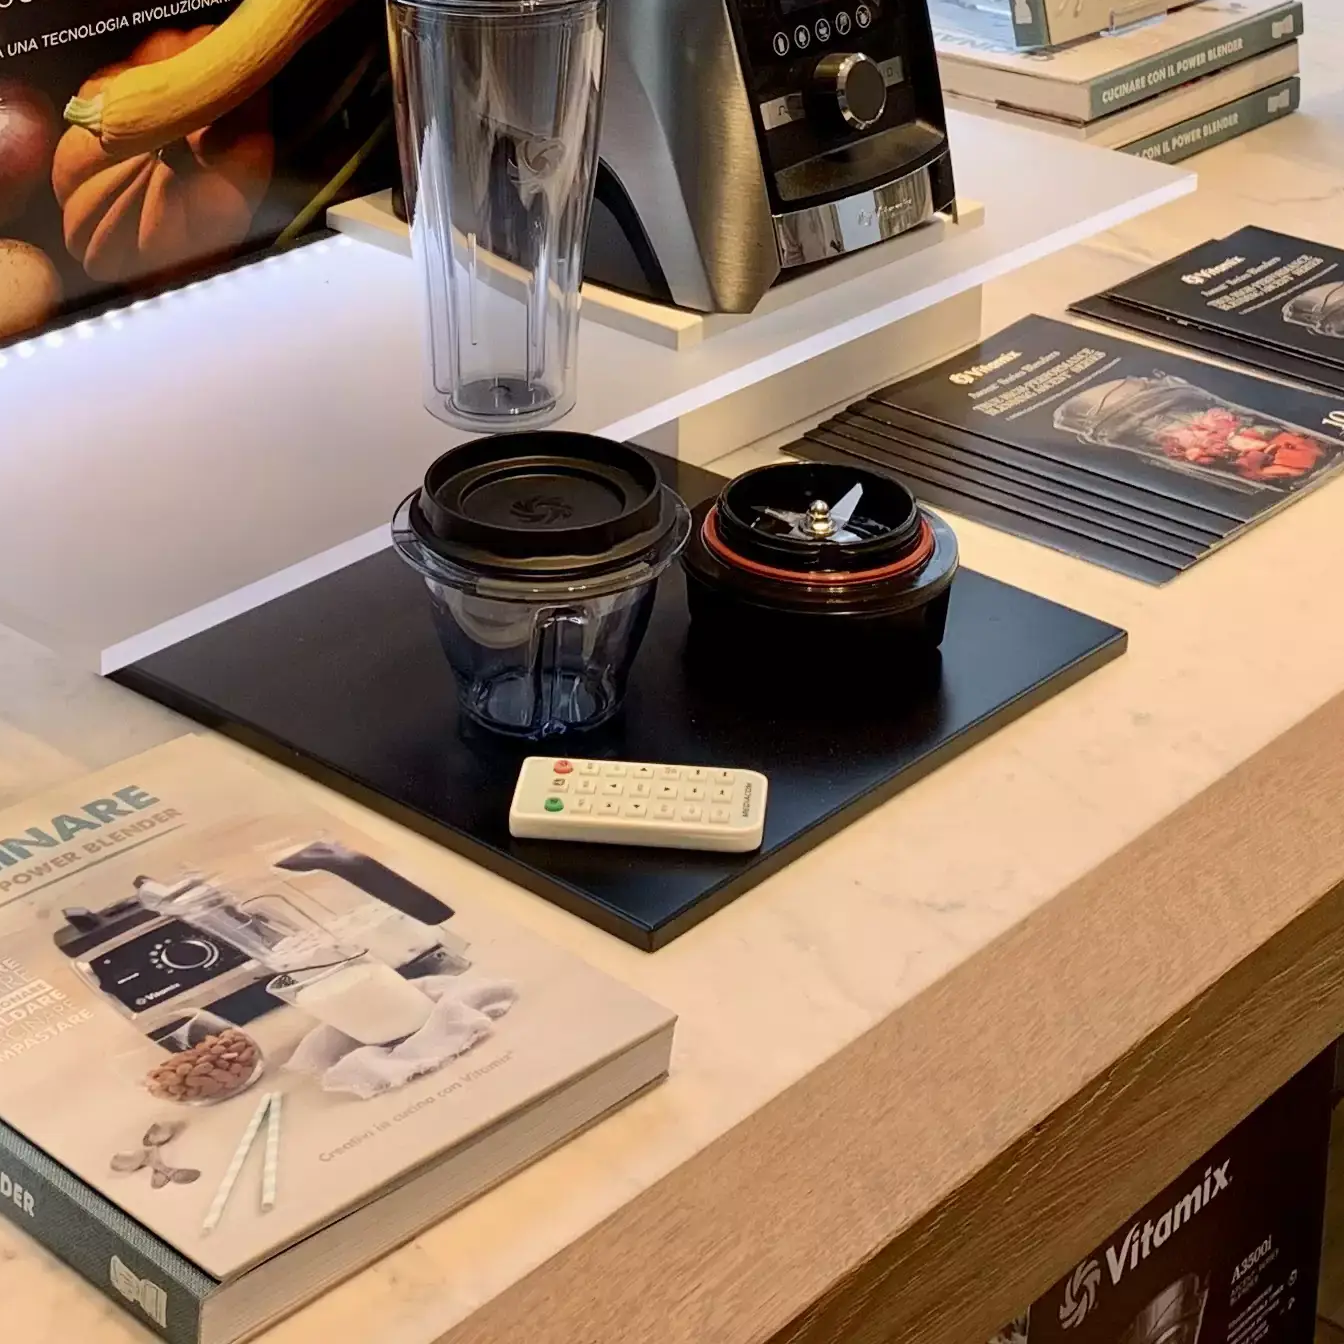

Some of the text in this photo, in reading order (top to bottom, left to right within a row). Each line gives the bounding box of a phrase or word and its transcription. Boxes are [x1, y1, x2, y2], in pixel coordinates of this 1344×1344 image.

[6, 37, 39, 59] UNA
[41, 16, 130, 48] TECNOLOGIA
[1102, 38, 1243, 104] CUCINARE CON IL POWER BLENDER
[1162, 138, 1170, 152] IL
[1171, 126, 1202, 149] POWER
[1203, 113, 1239, 137] BLENDER
[81, 807, 183, 855] BLENDER
[393, 1096, 436, 1123] cucina
[437, 1081, 463, 1098] con
[1105, 1158, 1233, 1286] Vitamix
